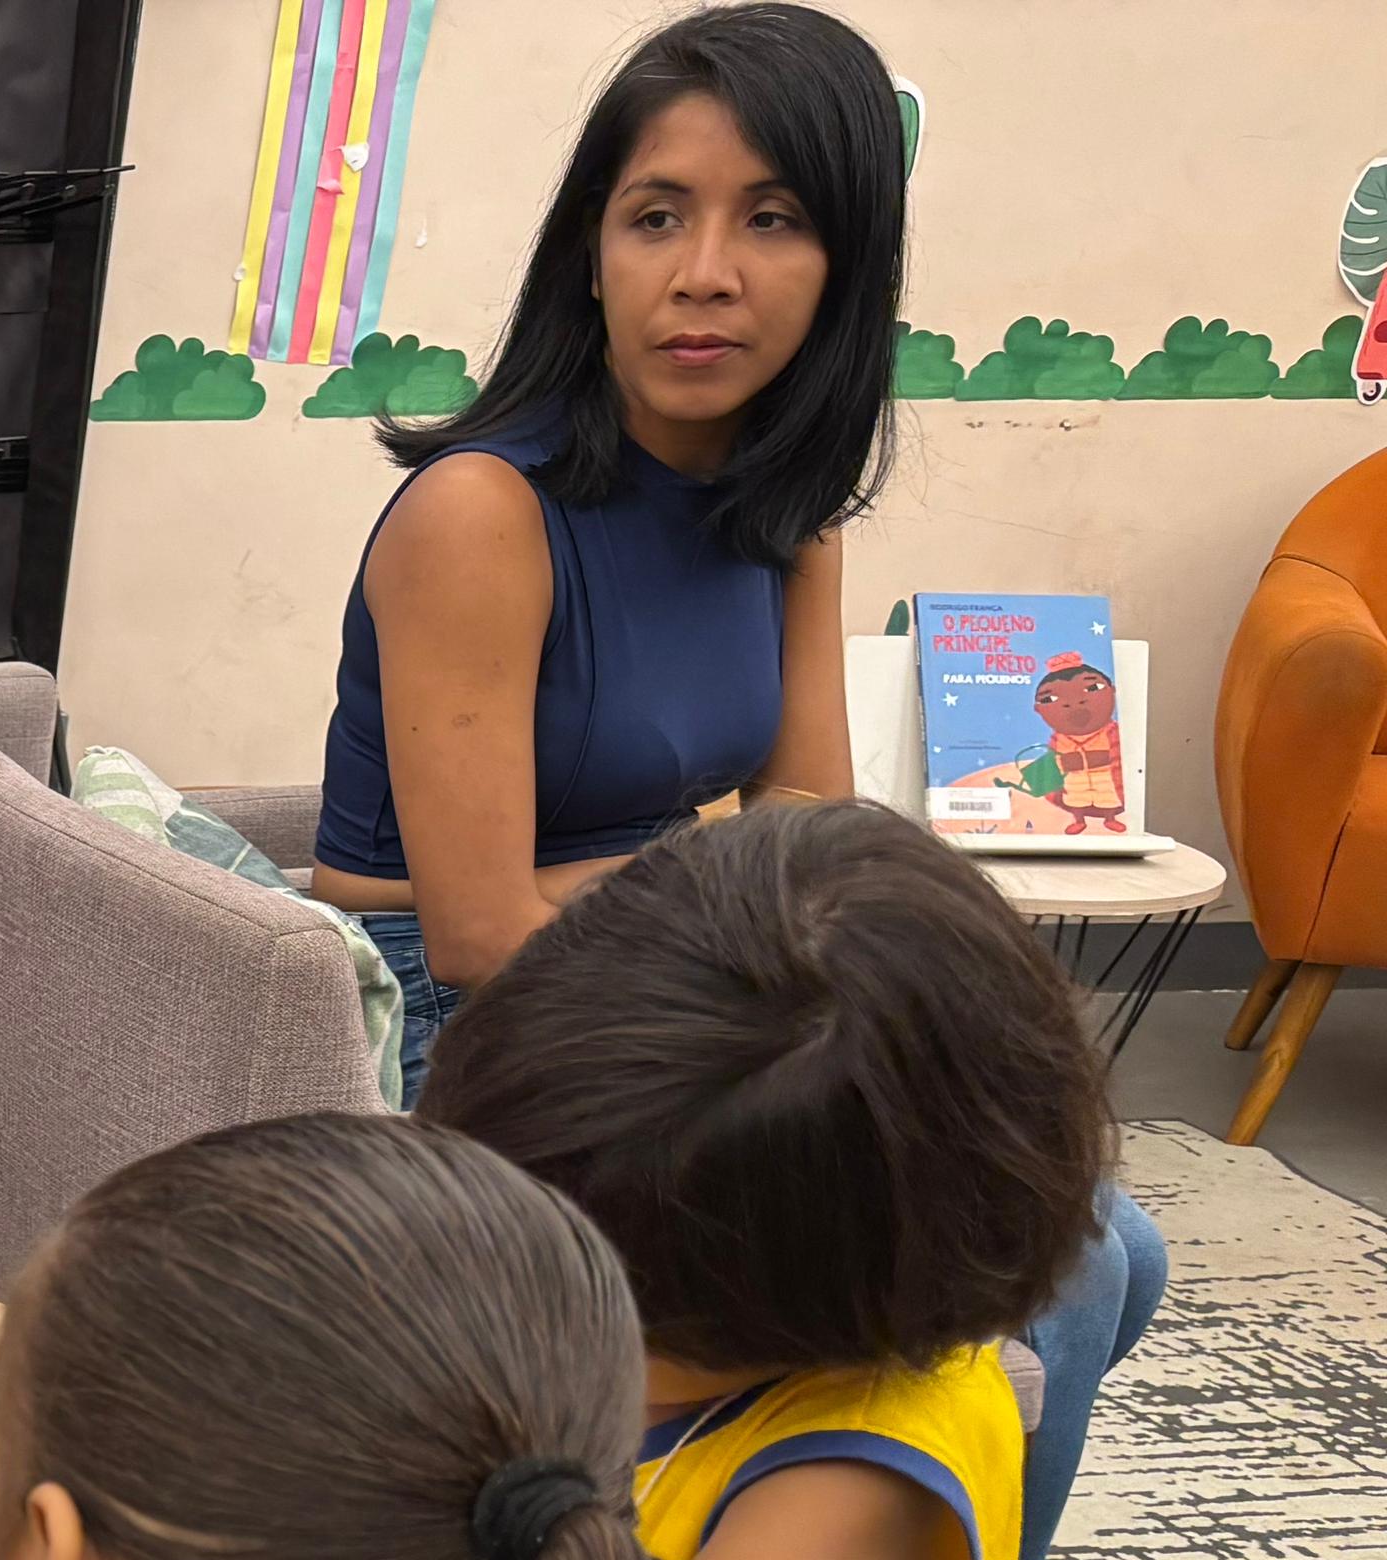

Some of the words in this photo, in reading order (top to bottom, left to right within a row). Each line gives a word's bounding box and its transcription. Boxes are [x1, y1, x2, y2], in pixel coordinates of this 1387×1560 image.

[943, 614, 955, 632] O
[960, 614, 1035, 633] PEQUENO
[984, 653, 1037, 673] PRETO
[943, 674, 973, 684] PARA
[975, 674, 1032, 685] PEQUENOS
